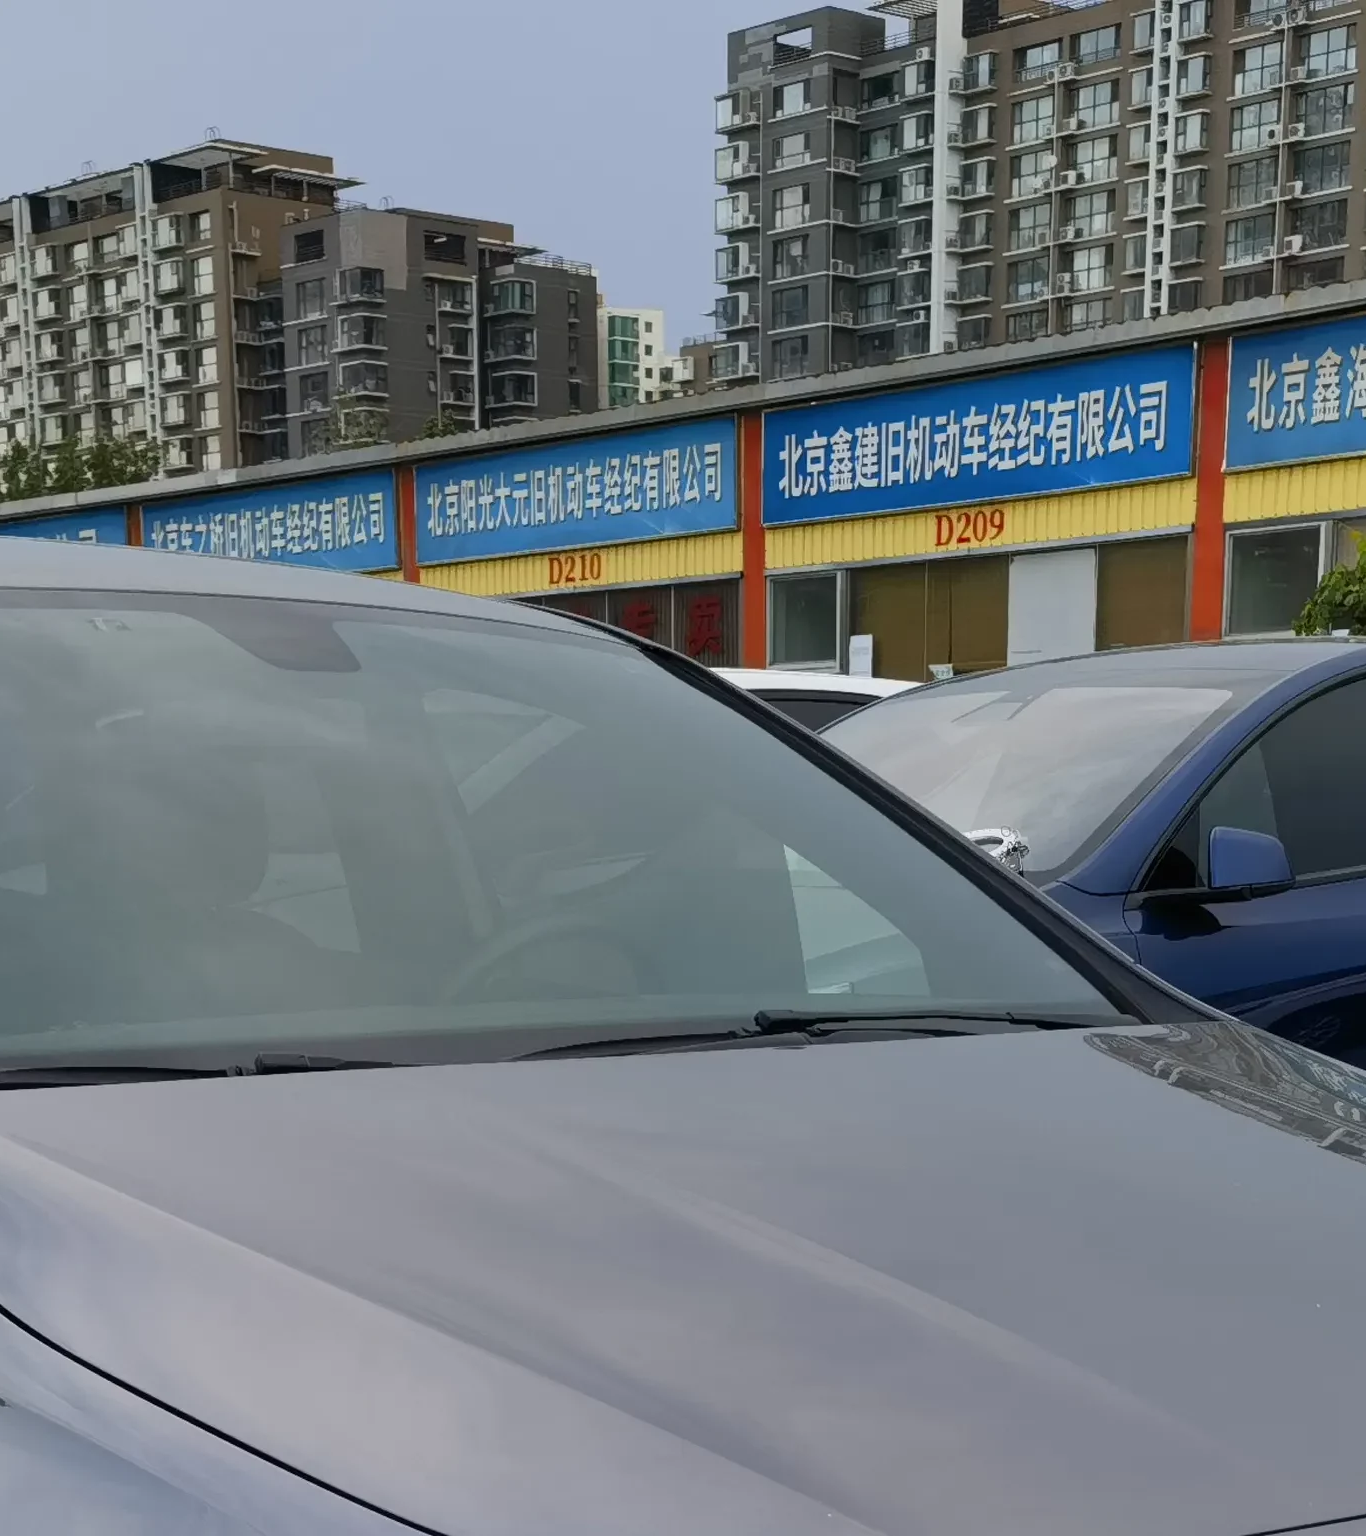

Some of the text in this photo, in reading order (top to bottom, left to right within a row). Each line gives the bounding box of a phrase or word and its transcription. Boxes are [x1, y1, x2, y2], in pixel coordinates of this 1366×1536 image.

[778, 380, 1168, 500] 北京鑫建旧机动车经纪有限公司
[426, 442, 722, 537] 北京阳光大元旧机动车经纪有限公司
[934, 509, 1006, 547] D209
[547, 552, 602, 585] D210
